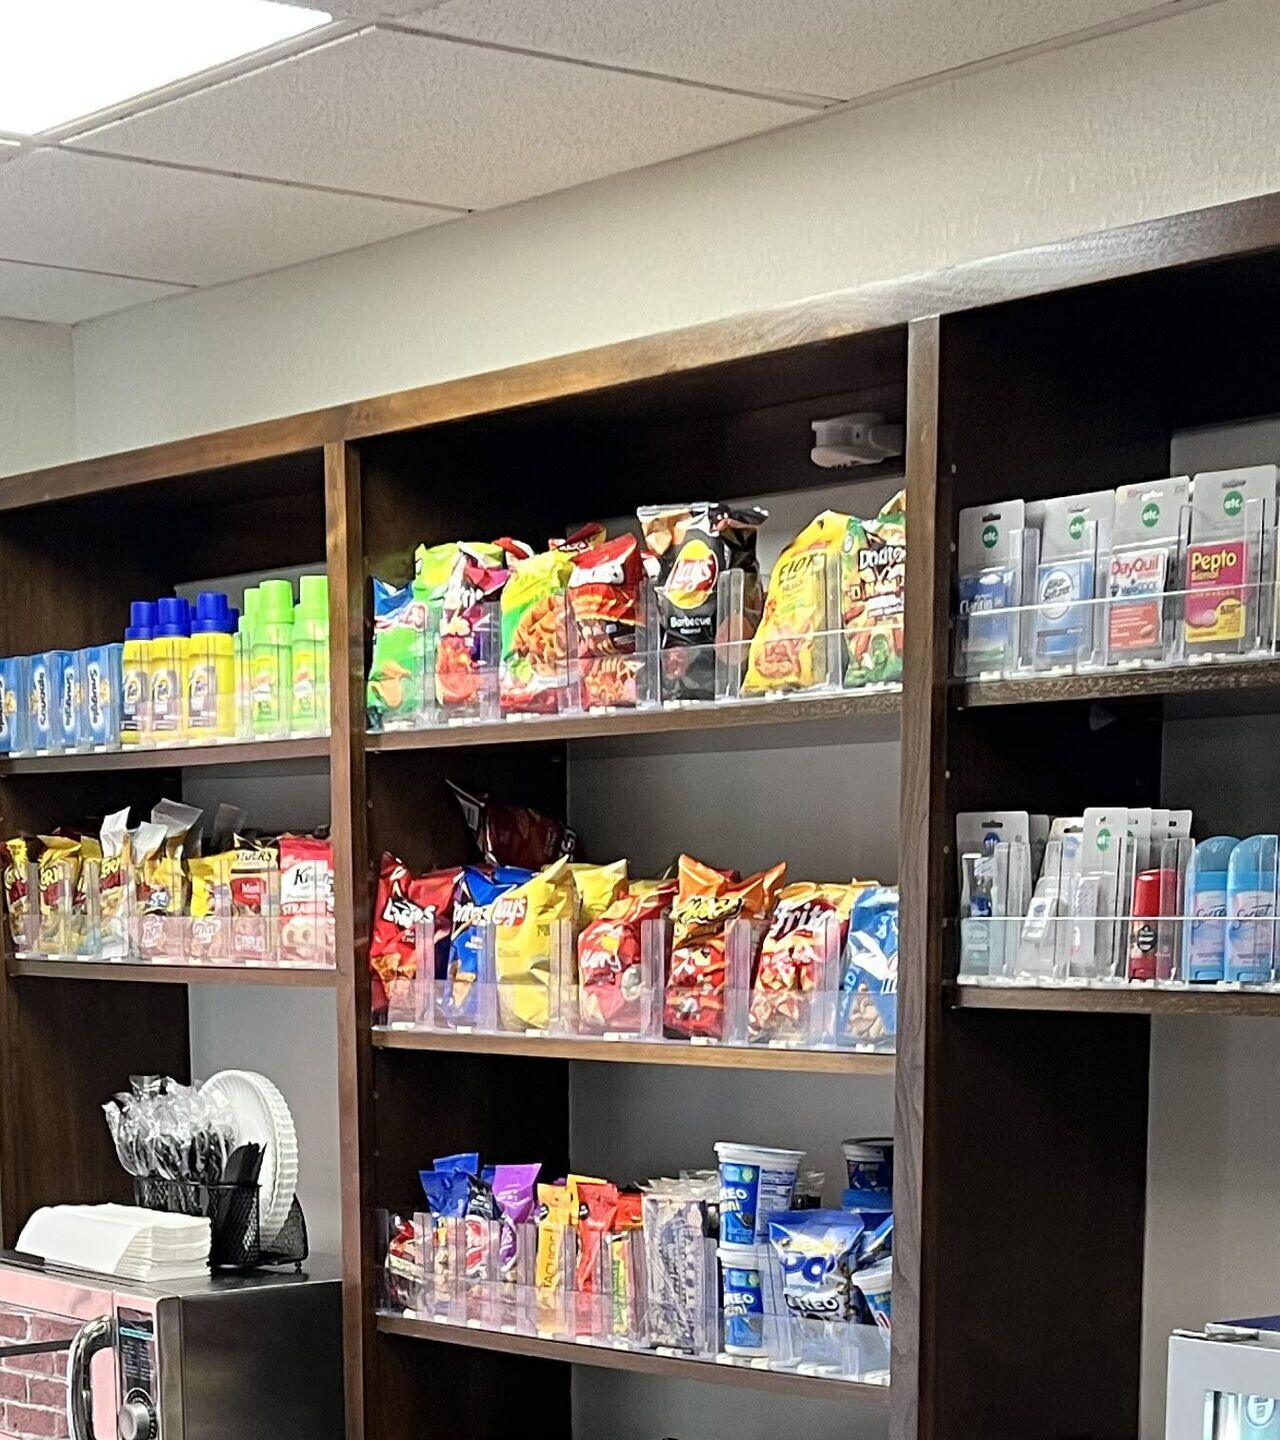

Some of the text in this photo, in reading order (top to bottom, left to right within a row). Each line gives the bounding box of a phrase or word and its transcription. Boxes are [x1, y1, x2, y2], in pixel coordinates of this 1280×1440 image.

[1111, 555, 1159, 579] DayQuil
[1192, 550, 1237, 571] Pepto
[669, 616, 712, 629] Barbecue
[720, 1188, 748, 1200] REO
[724, 1293, 755, 1305] REO
